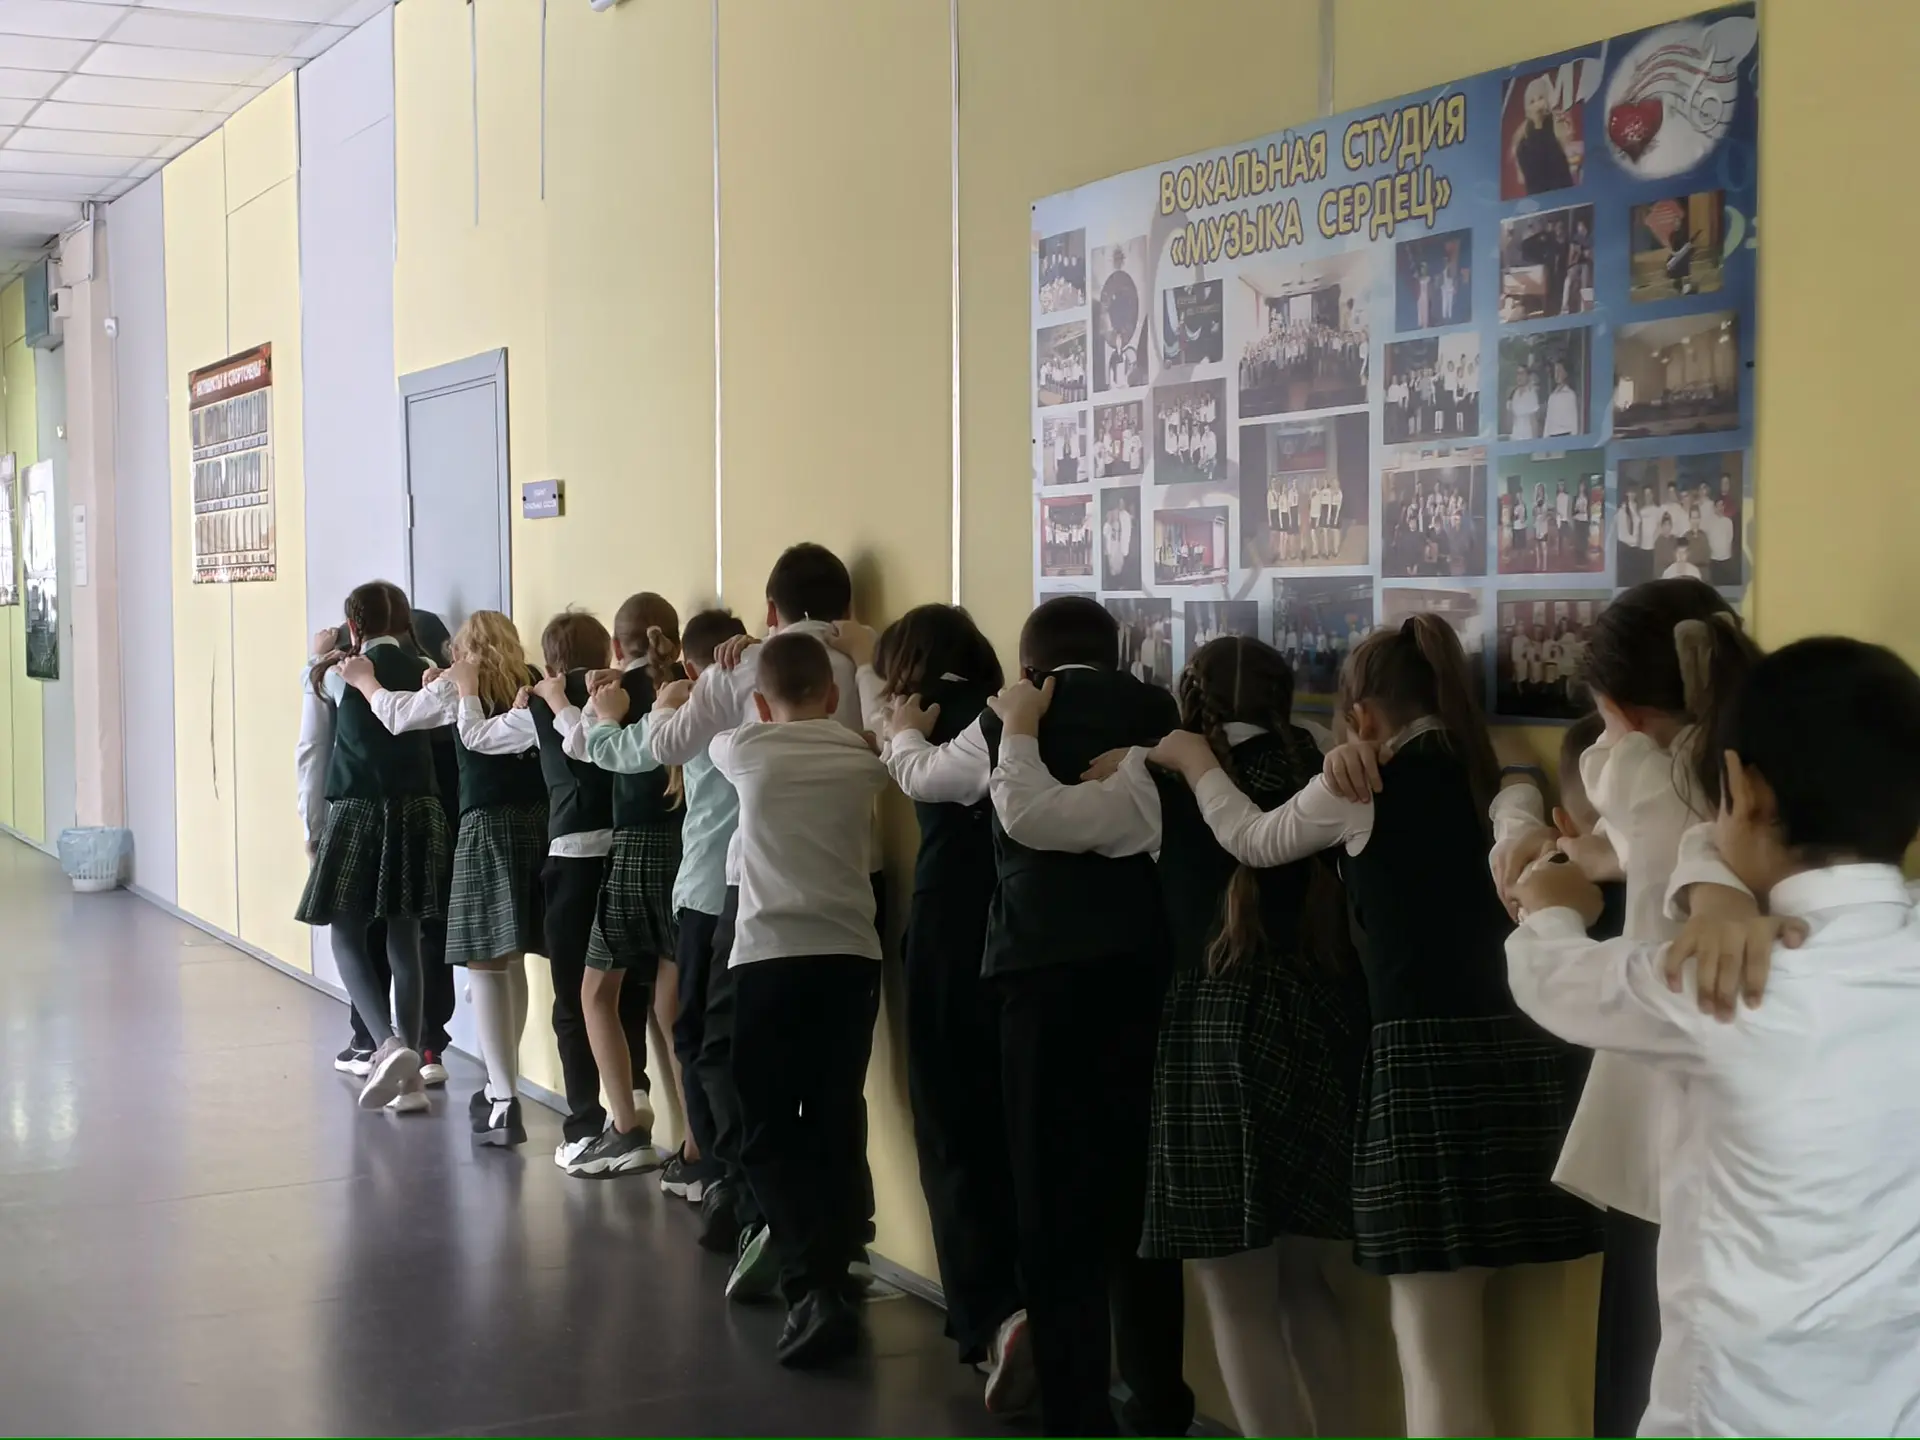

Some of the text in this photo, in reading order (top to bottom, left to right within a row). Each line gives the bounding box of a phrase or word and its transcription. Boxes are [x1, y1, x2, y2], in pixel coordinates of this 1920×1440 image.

[1160, 92, 1466, 215] ВОКАЛЬНАЯ СТУДИЯ
[1171, 164, 1452, 267] «МУЗЫКА СЕРДЕЦ»
